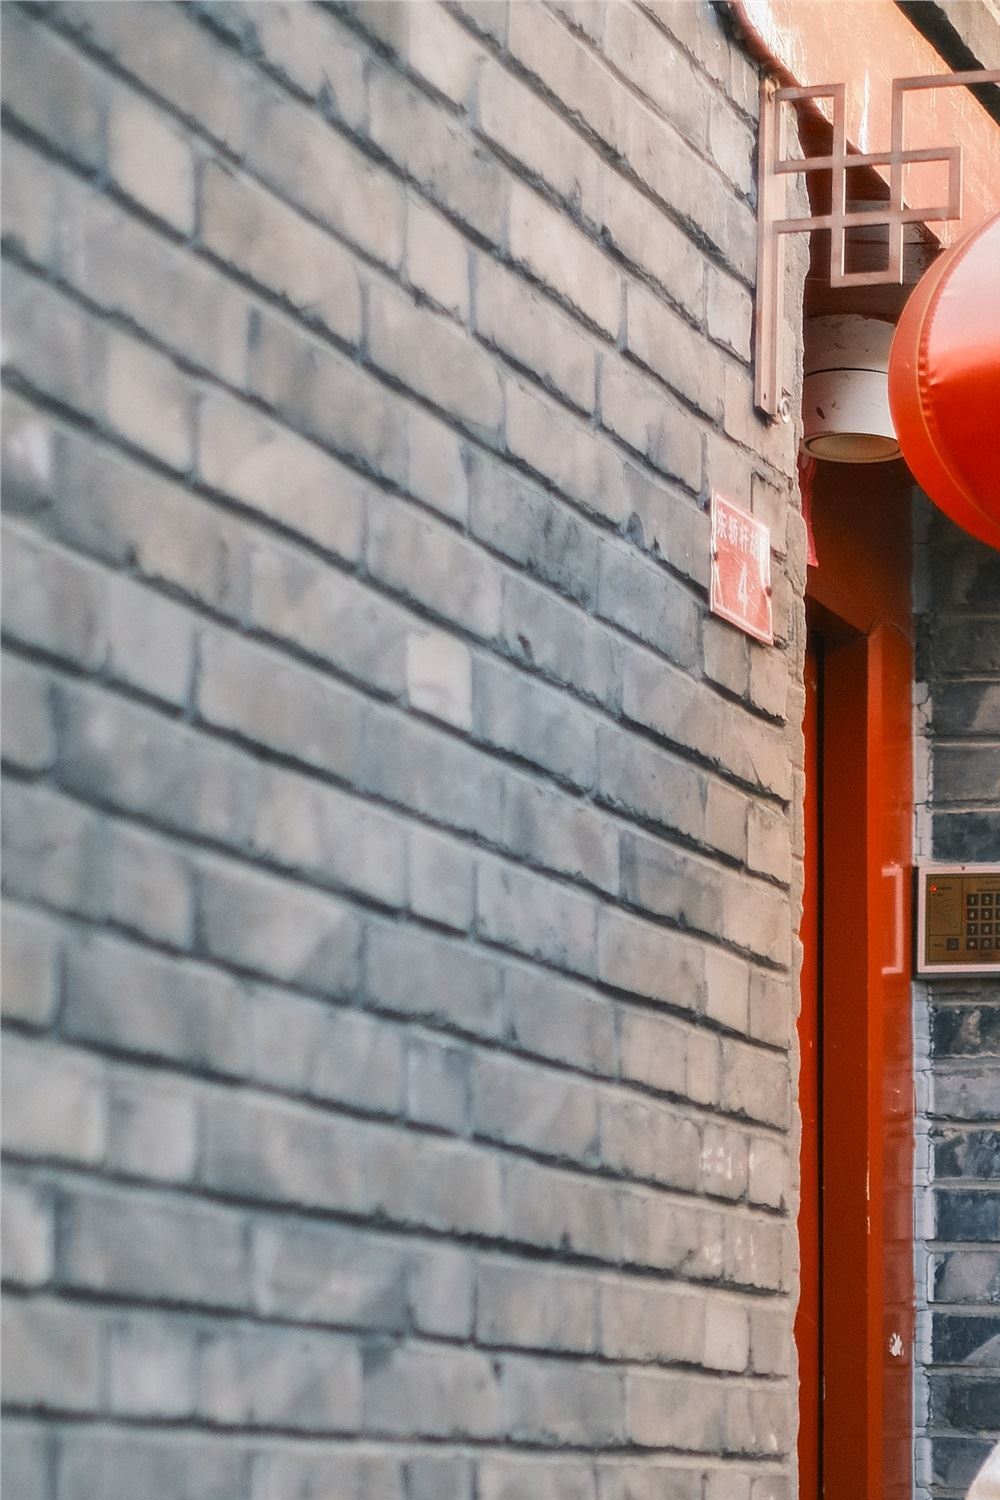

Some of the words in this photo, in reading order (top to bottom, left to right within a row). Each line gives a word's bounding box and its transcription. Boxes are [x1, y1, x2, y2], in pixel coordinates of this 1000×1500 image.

[717, 508, 769, 566] 东轿杆胡
[738, 561, 749, 617] 4
